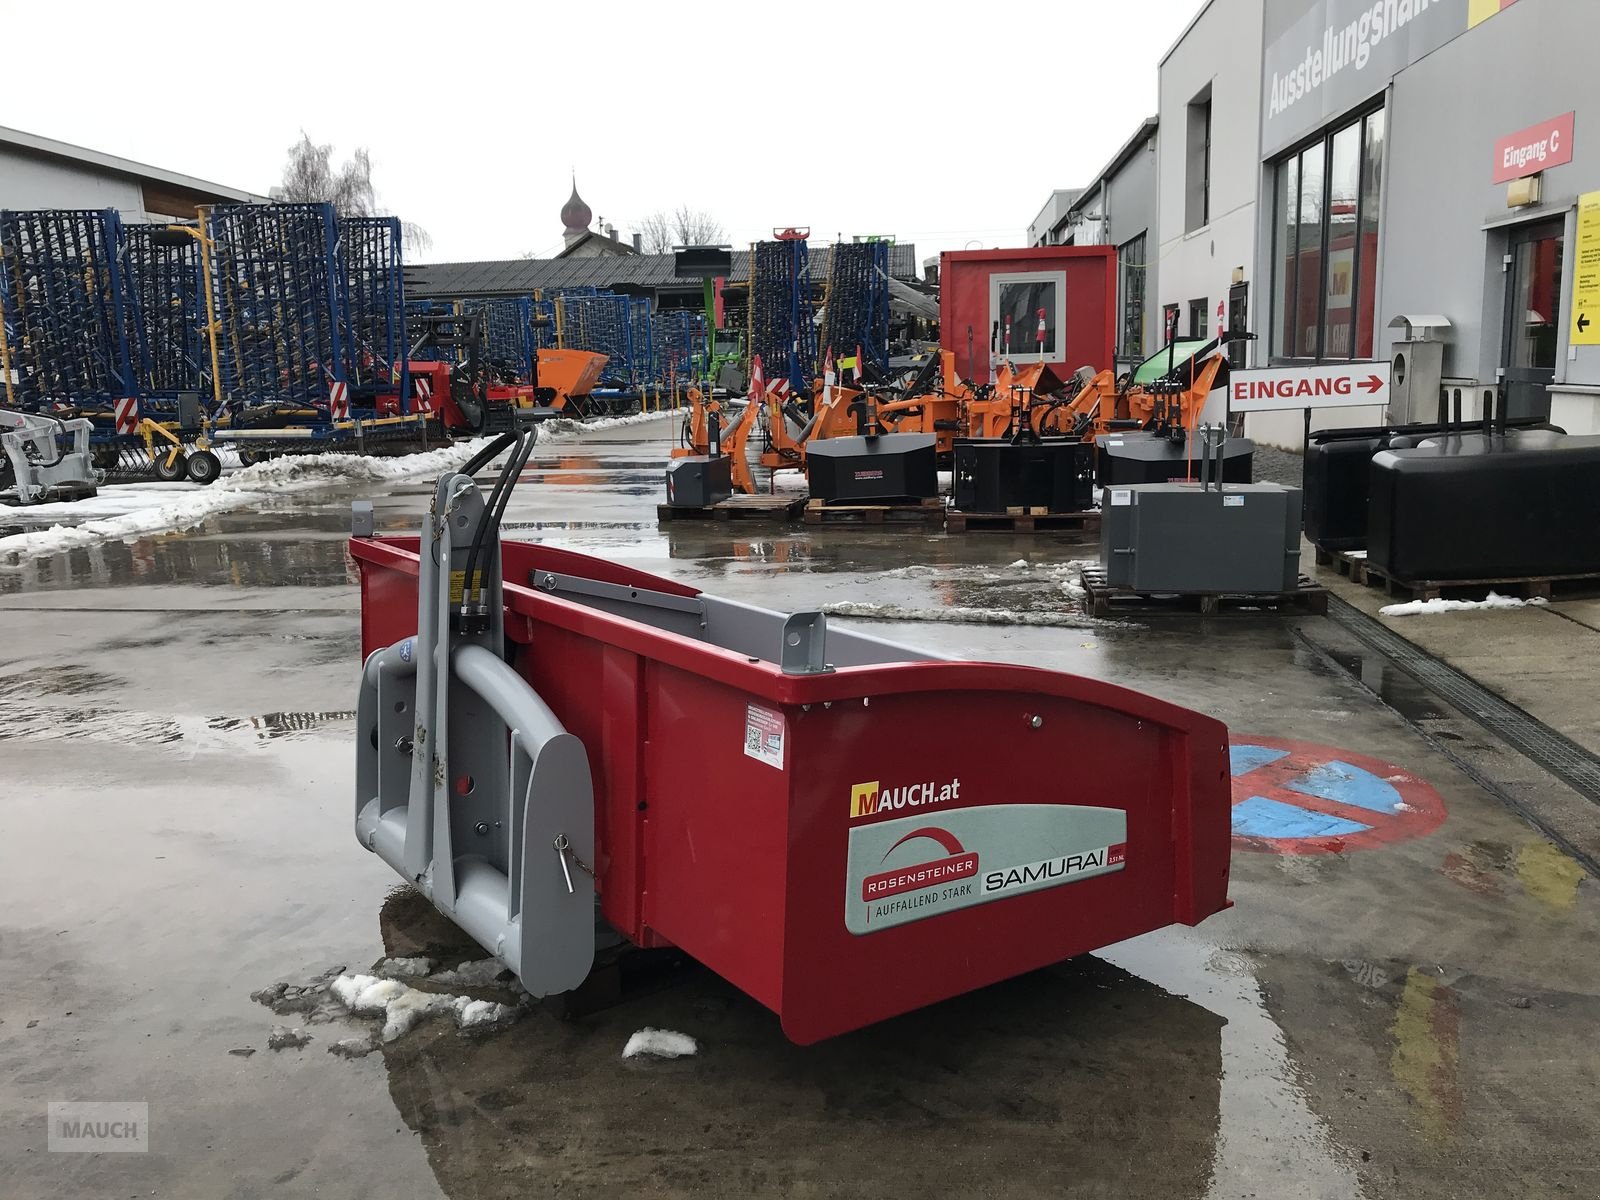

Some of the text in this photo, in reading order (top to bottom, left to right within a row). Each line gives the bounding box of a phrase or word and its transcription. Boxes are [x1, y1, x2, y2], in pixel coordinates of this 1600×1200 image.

[1269, 0, 1440, 119] Ausstellungsha
[1503, 129, 1560, 168] Eingang C
[1234, 376, 1351, 400] EINGANG
[857, 778, 961, 816] MAUCH.at
[868, 860, 973, 893] ROSENSTEINER
[986, 850, 1104, 891] SAMURAI
[875, 884, 972, 917] AUFFALLEND STARK
